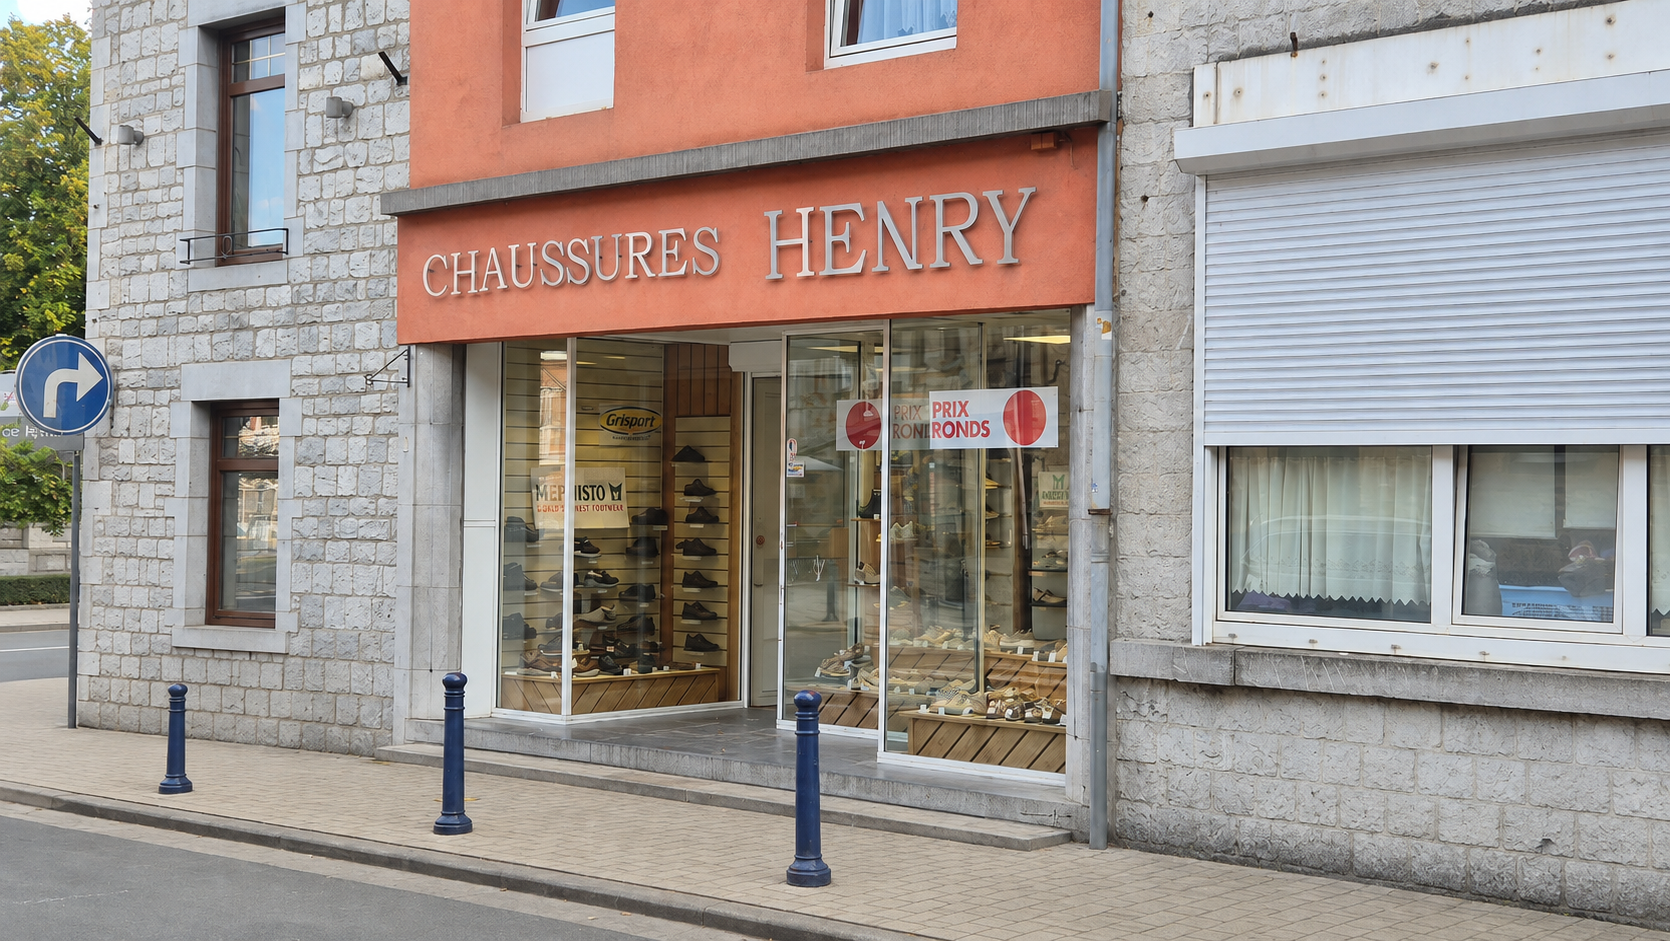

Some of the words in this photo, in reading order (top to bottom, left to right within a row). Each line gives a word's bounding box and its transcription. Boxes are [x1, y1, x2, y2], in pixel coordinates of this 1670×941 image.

[422, 227, 720, 297] CHAUSSURES
[763, 187, 1037, 280] HENRY
[894, 405, 922, 421] PRIX
[932, 400, 970, 419] PRIX
[932, 420, 991, 439] RONDS
[536, 484, 606, 502] MEPISTO
